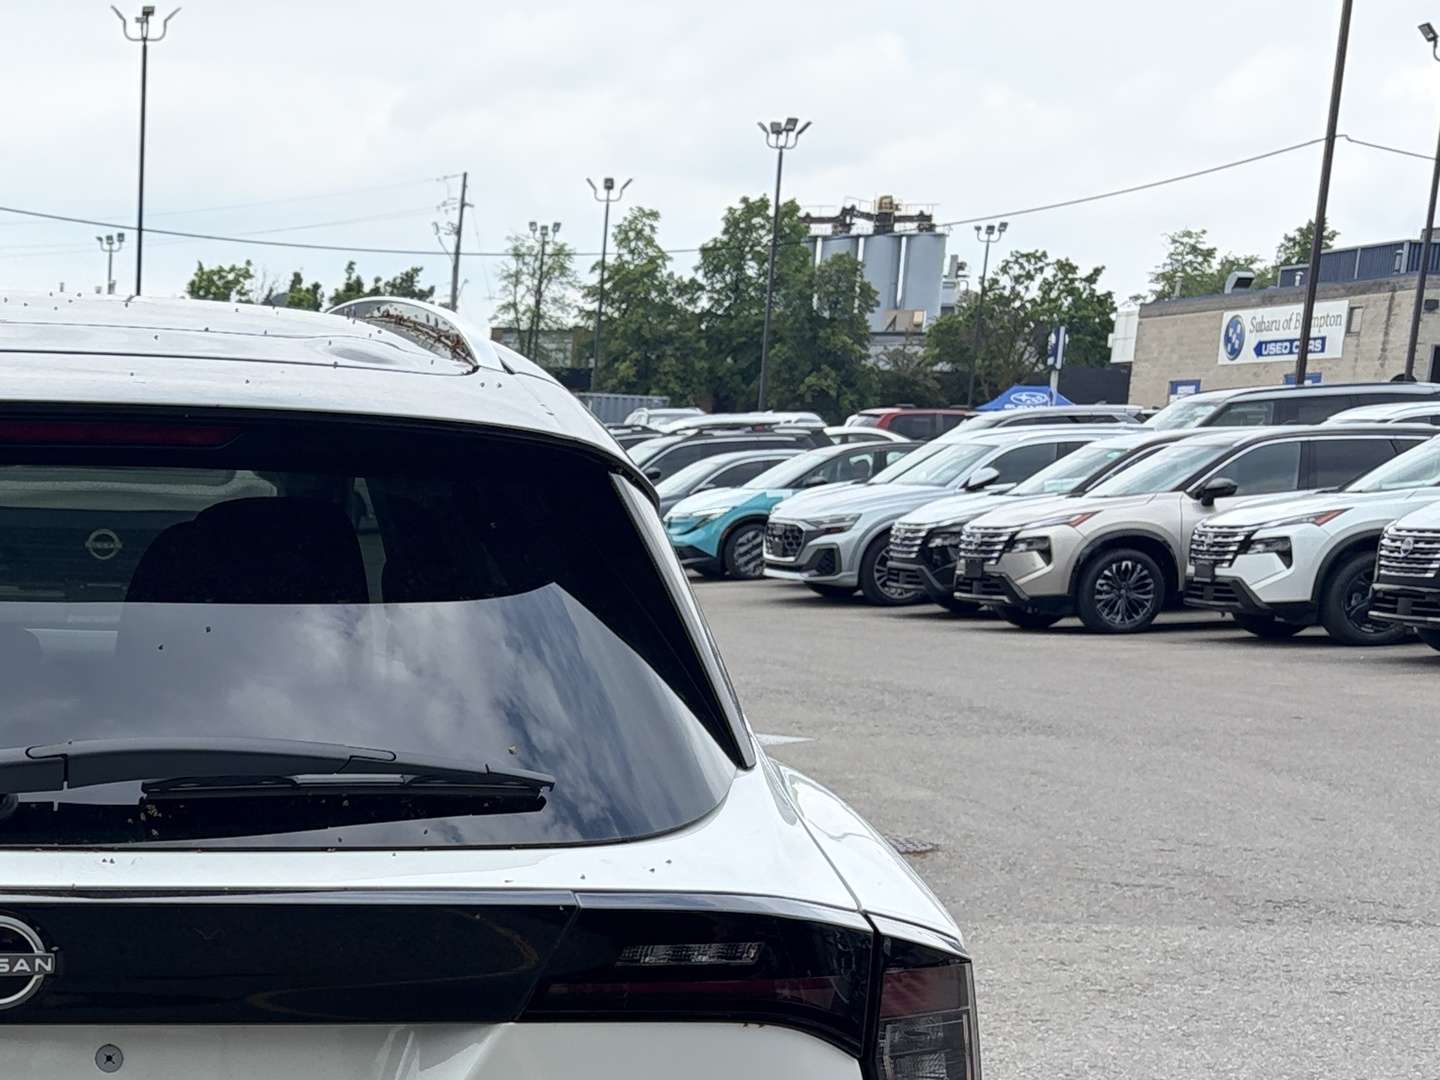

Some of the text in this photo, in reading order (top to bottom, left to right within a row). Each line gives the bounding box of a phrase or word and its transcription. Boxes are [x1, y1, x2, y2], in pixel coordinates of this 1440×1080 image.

[1249, 312, 1343, 334] Subaru of Bmpton
[1262, 339, 1322, 355] USED CRS
